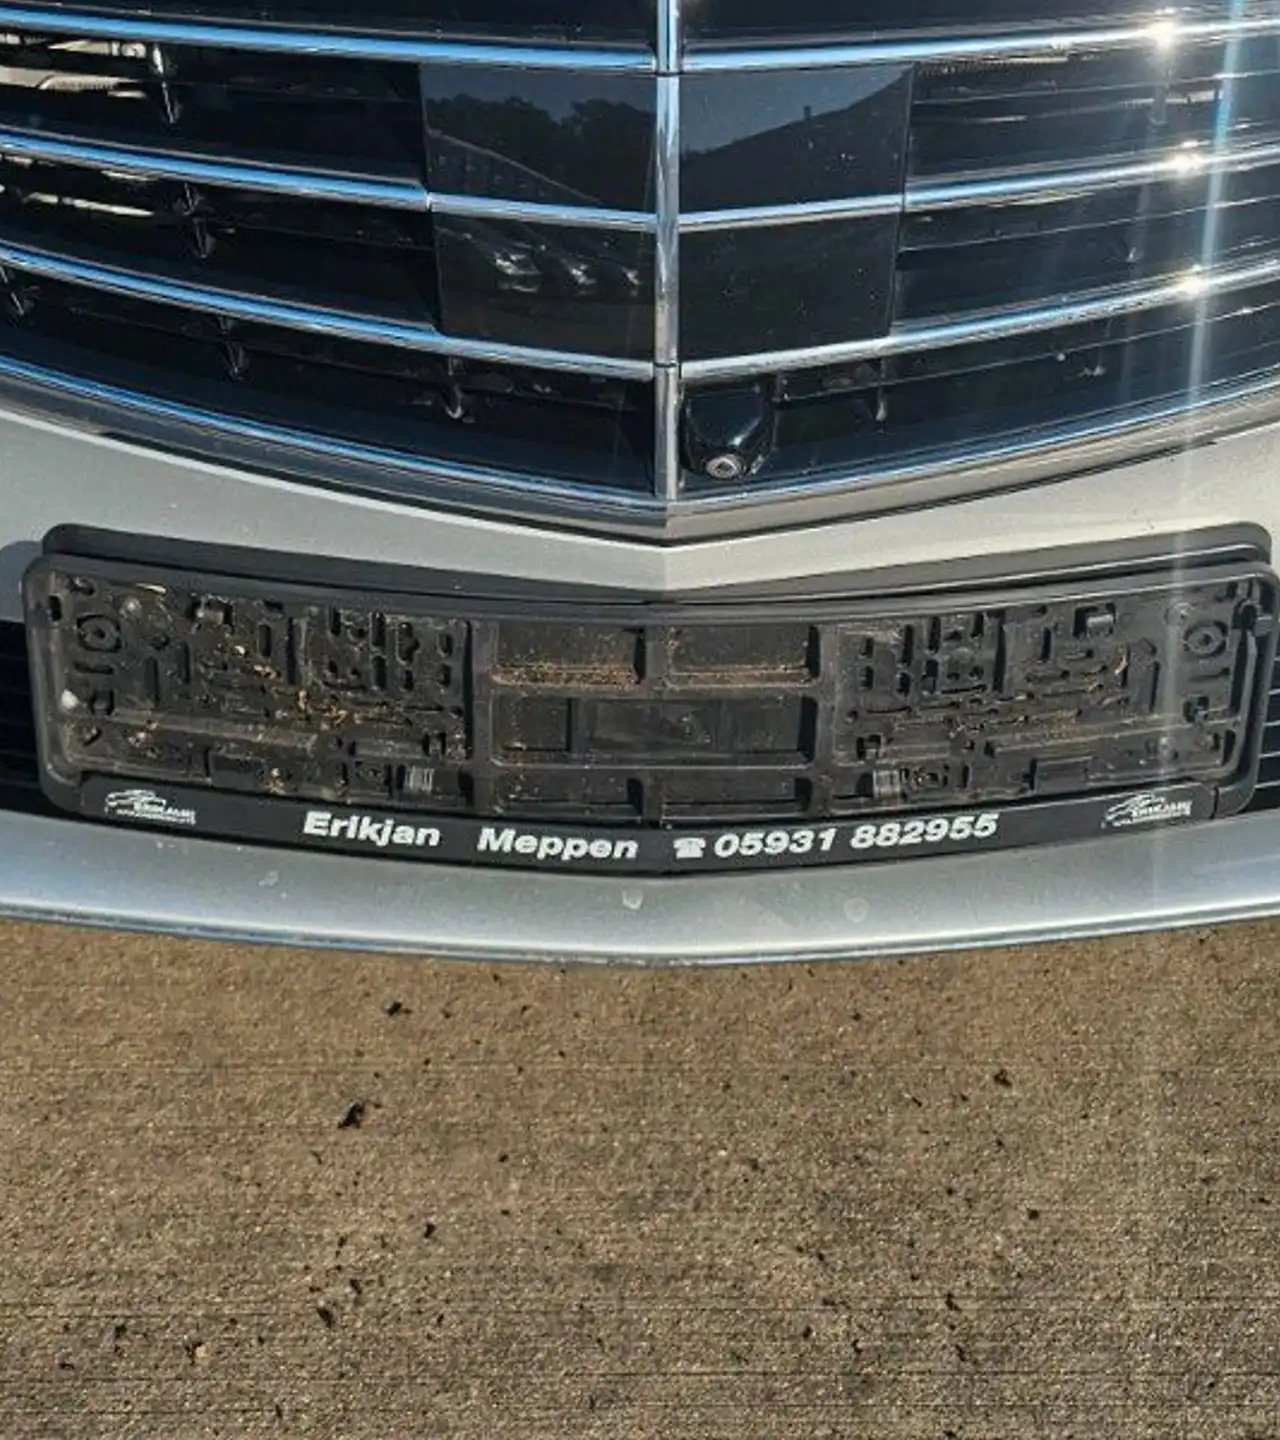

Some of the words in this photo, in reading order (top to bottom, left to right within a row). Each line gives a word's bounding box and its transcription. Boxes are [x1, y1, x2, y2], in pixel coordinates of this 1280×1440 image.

[303, 811, 441, 846] Erikjan
[477, 827, 638, 860] Meppen
[714, 828, 836, 857] 05931
[850, 813, 999, 849] 882955
